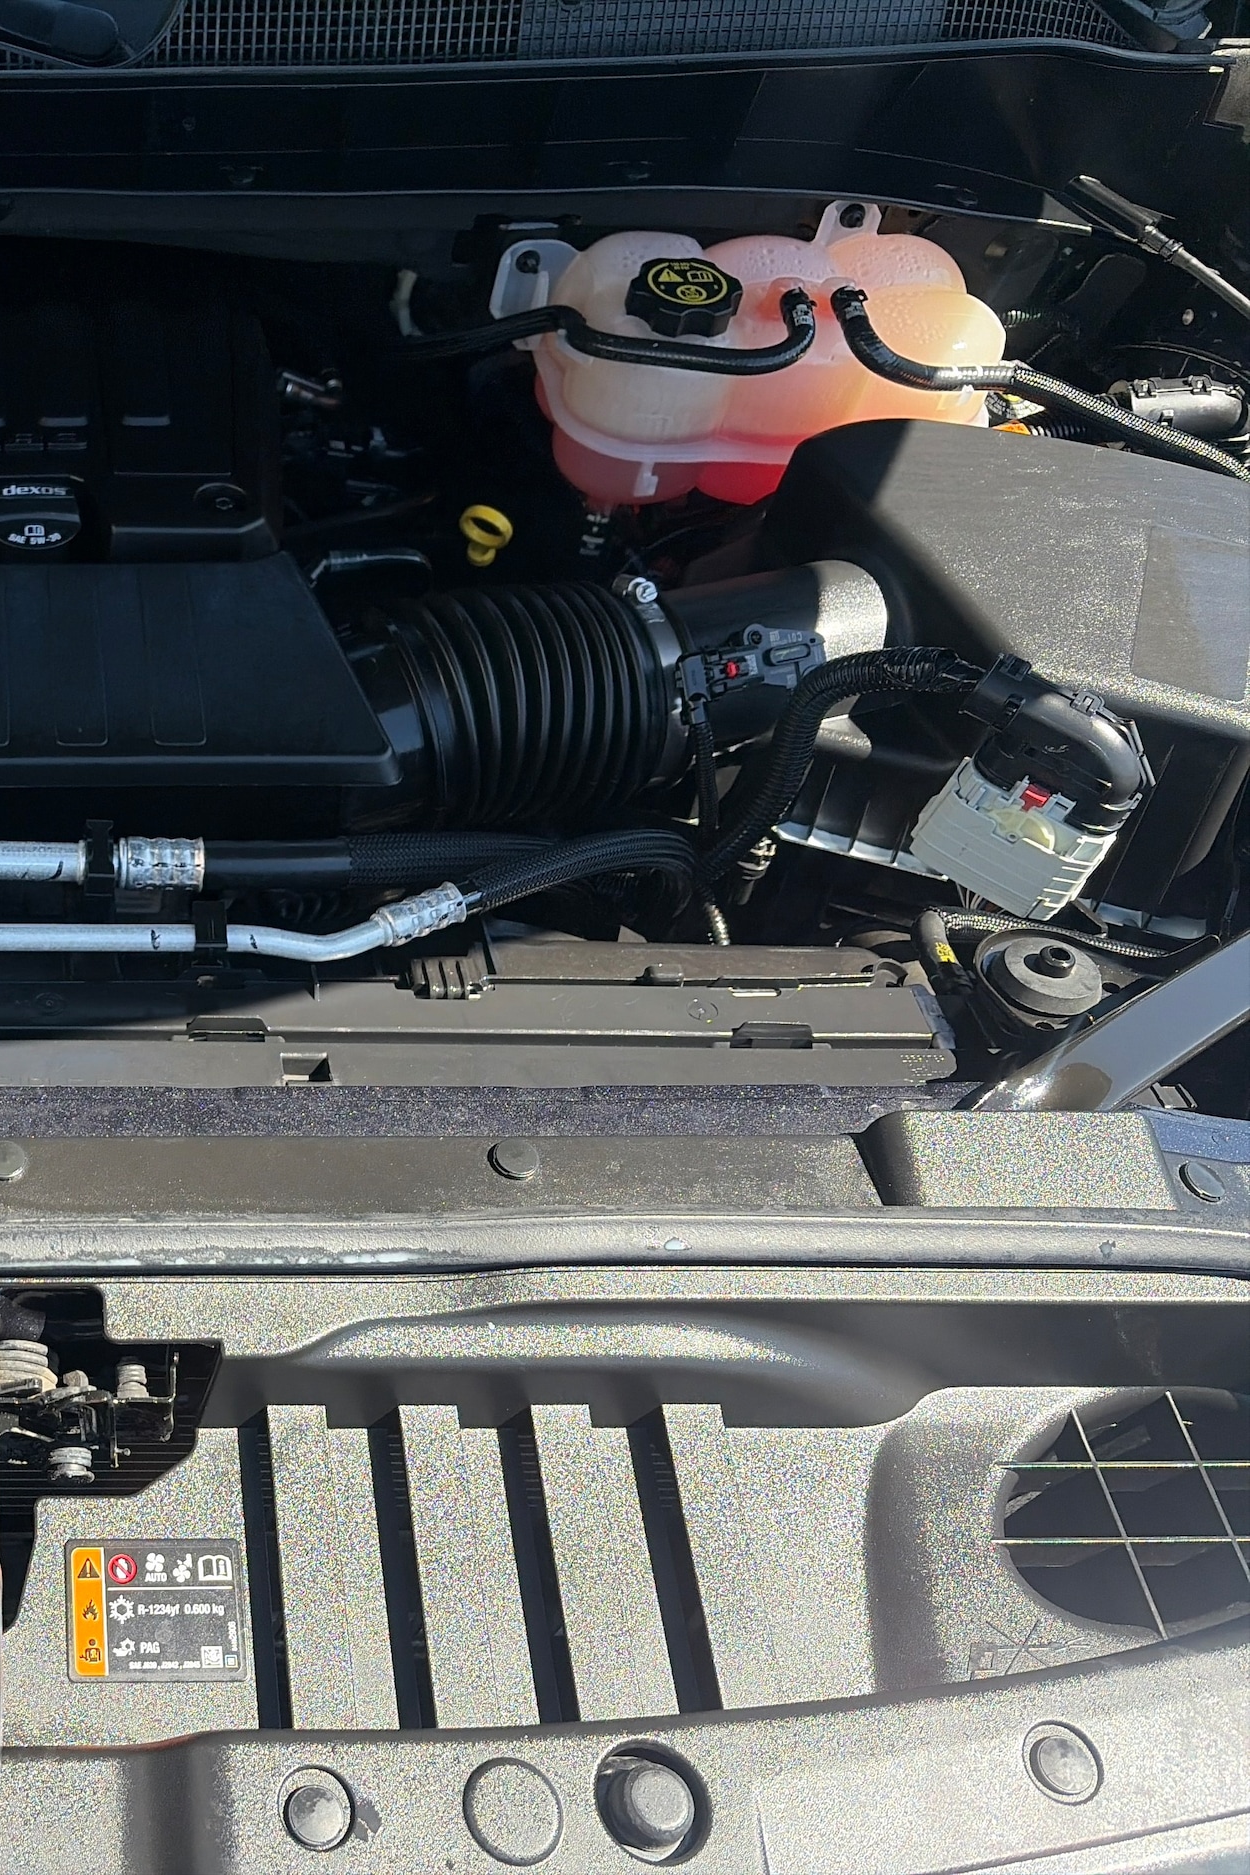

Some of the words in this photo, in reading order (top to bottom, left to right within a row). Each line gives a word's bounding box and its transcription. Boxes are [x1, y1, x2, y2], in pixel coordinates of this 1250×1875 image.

[2, 485, 67, 496] dexos
[8, 533, 27, 544] SAE
[145, 1572, 168, 1582] AUTO
[137, 1604, 180, 1617] R-1234yf
[184, 1603, 211, 1615] 0.600
[212, 1603, 225, 1616] kg
[140, 1641, 161, 1654] PAG
